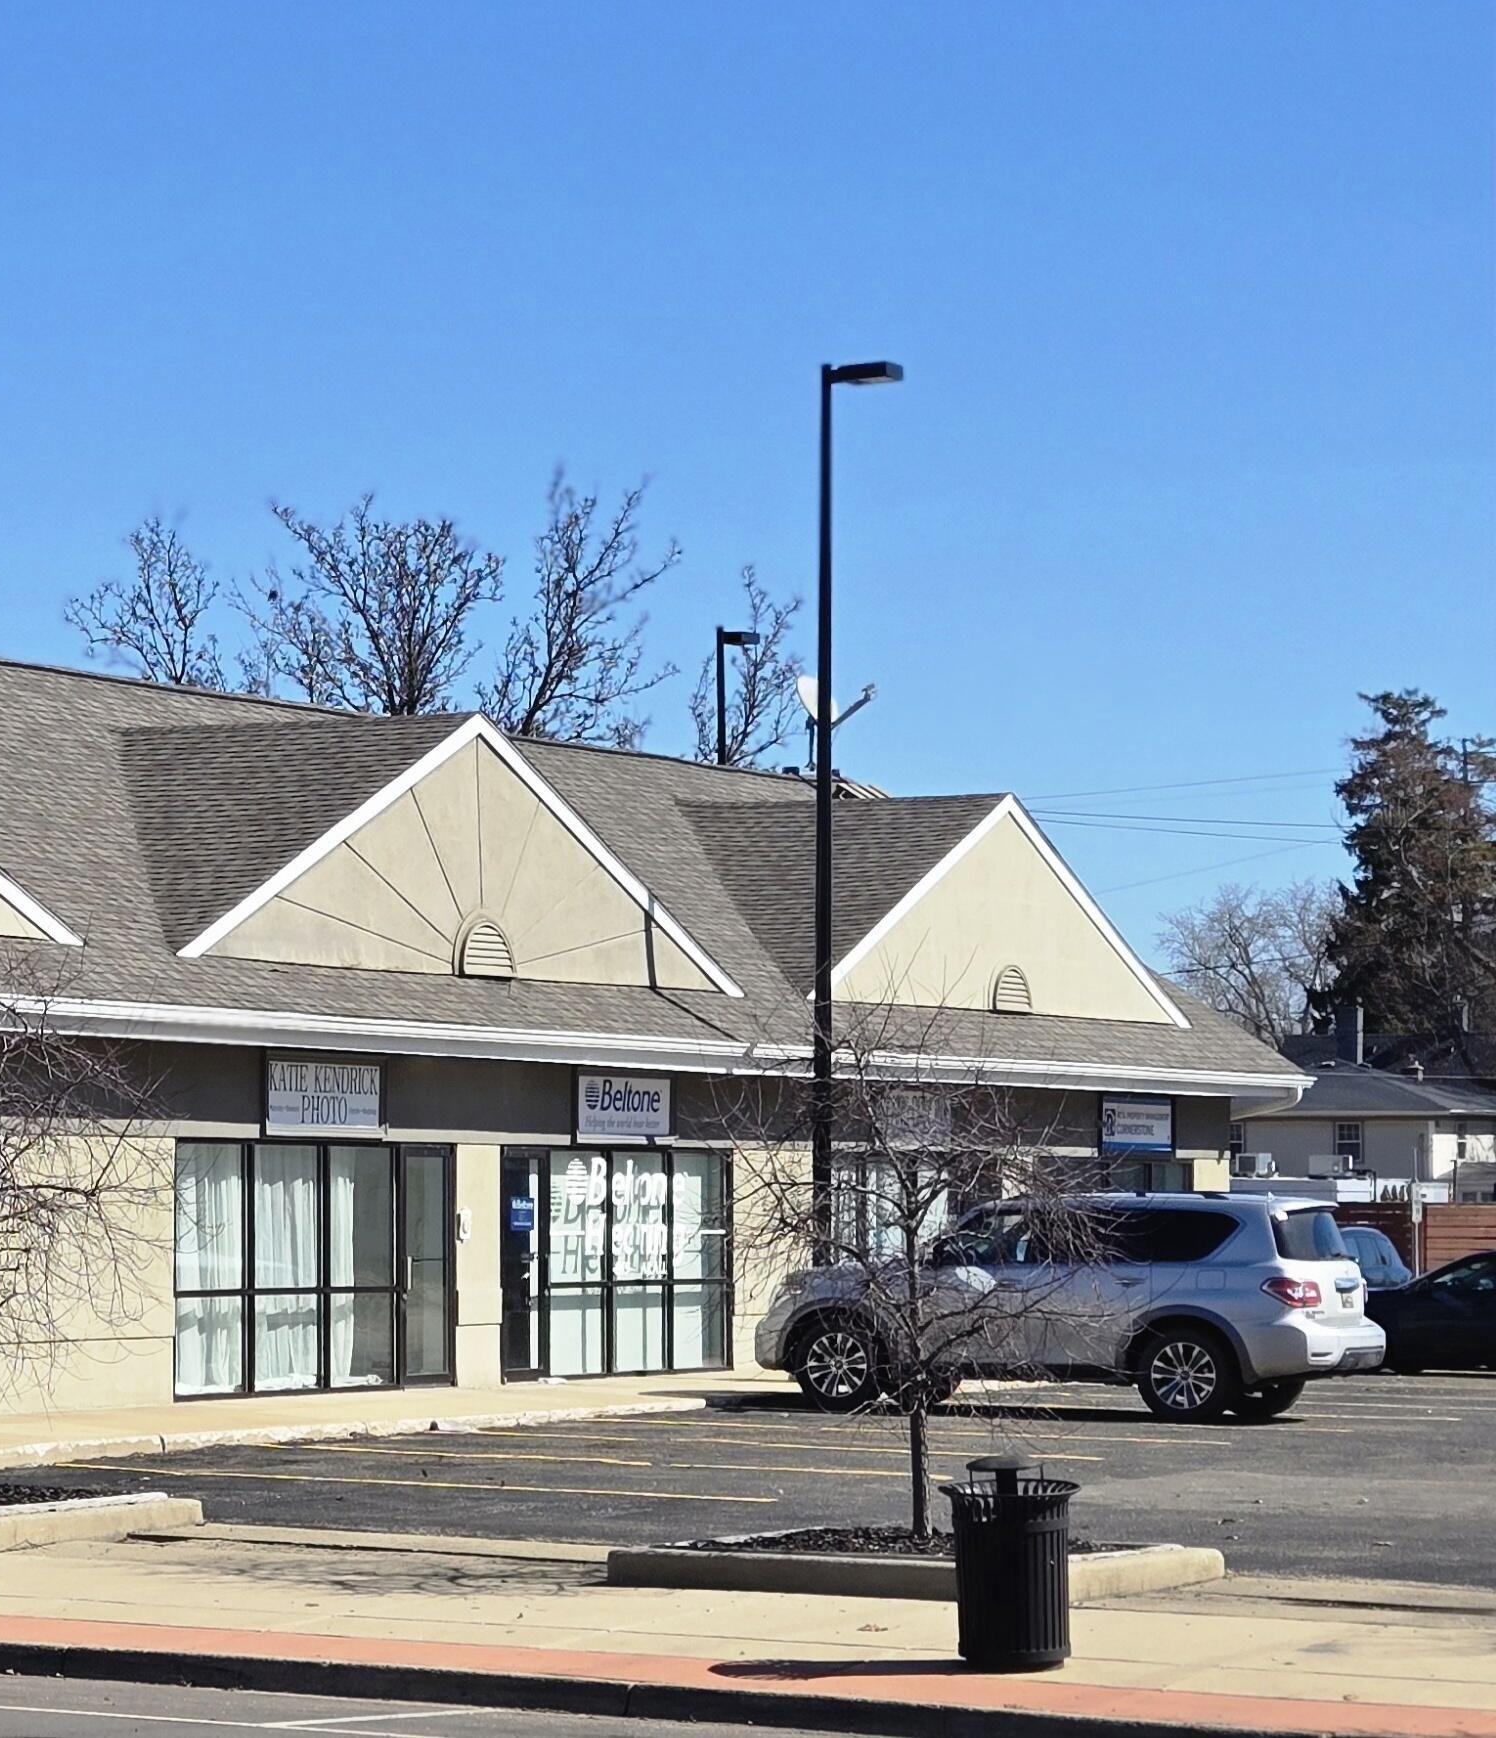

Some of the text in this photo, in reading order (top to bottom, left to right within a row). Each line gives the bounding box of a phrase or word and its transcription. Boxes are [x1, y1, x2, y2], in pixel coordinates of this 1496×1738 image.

[269, 1063, 378, 1095] KATIE KENDRICK
[301, 1095, 347, 1124] PHOTO
[600, 1079, 661, 1112] Beltone
